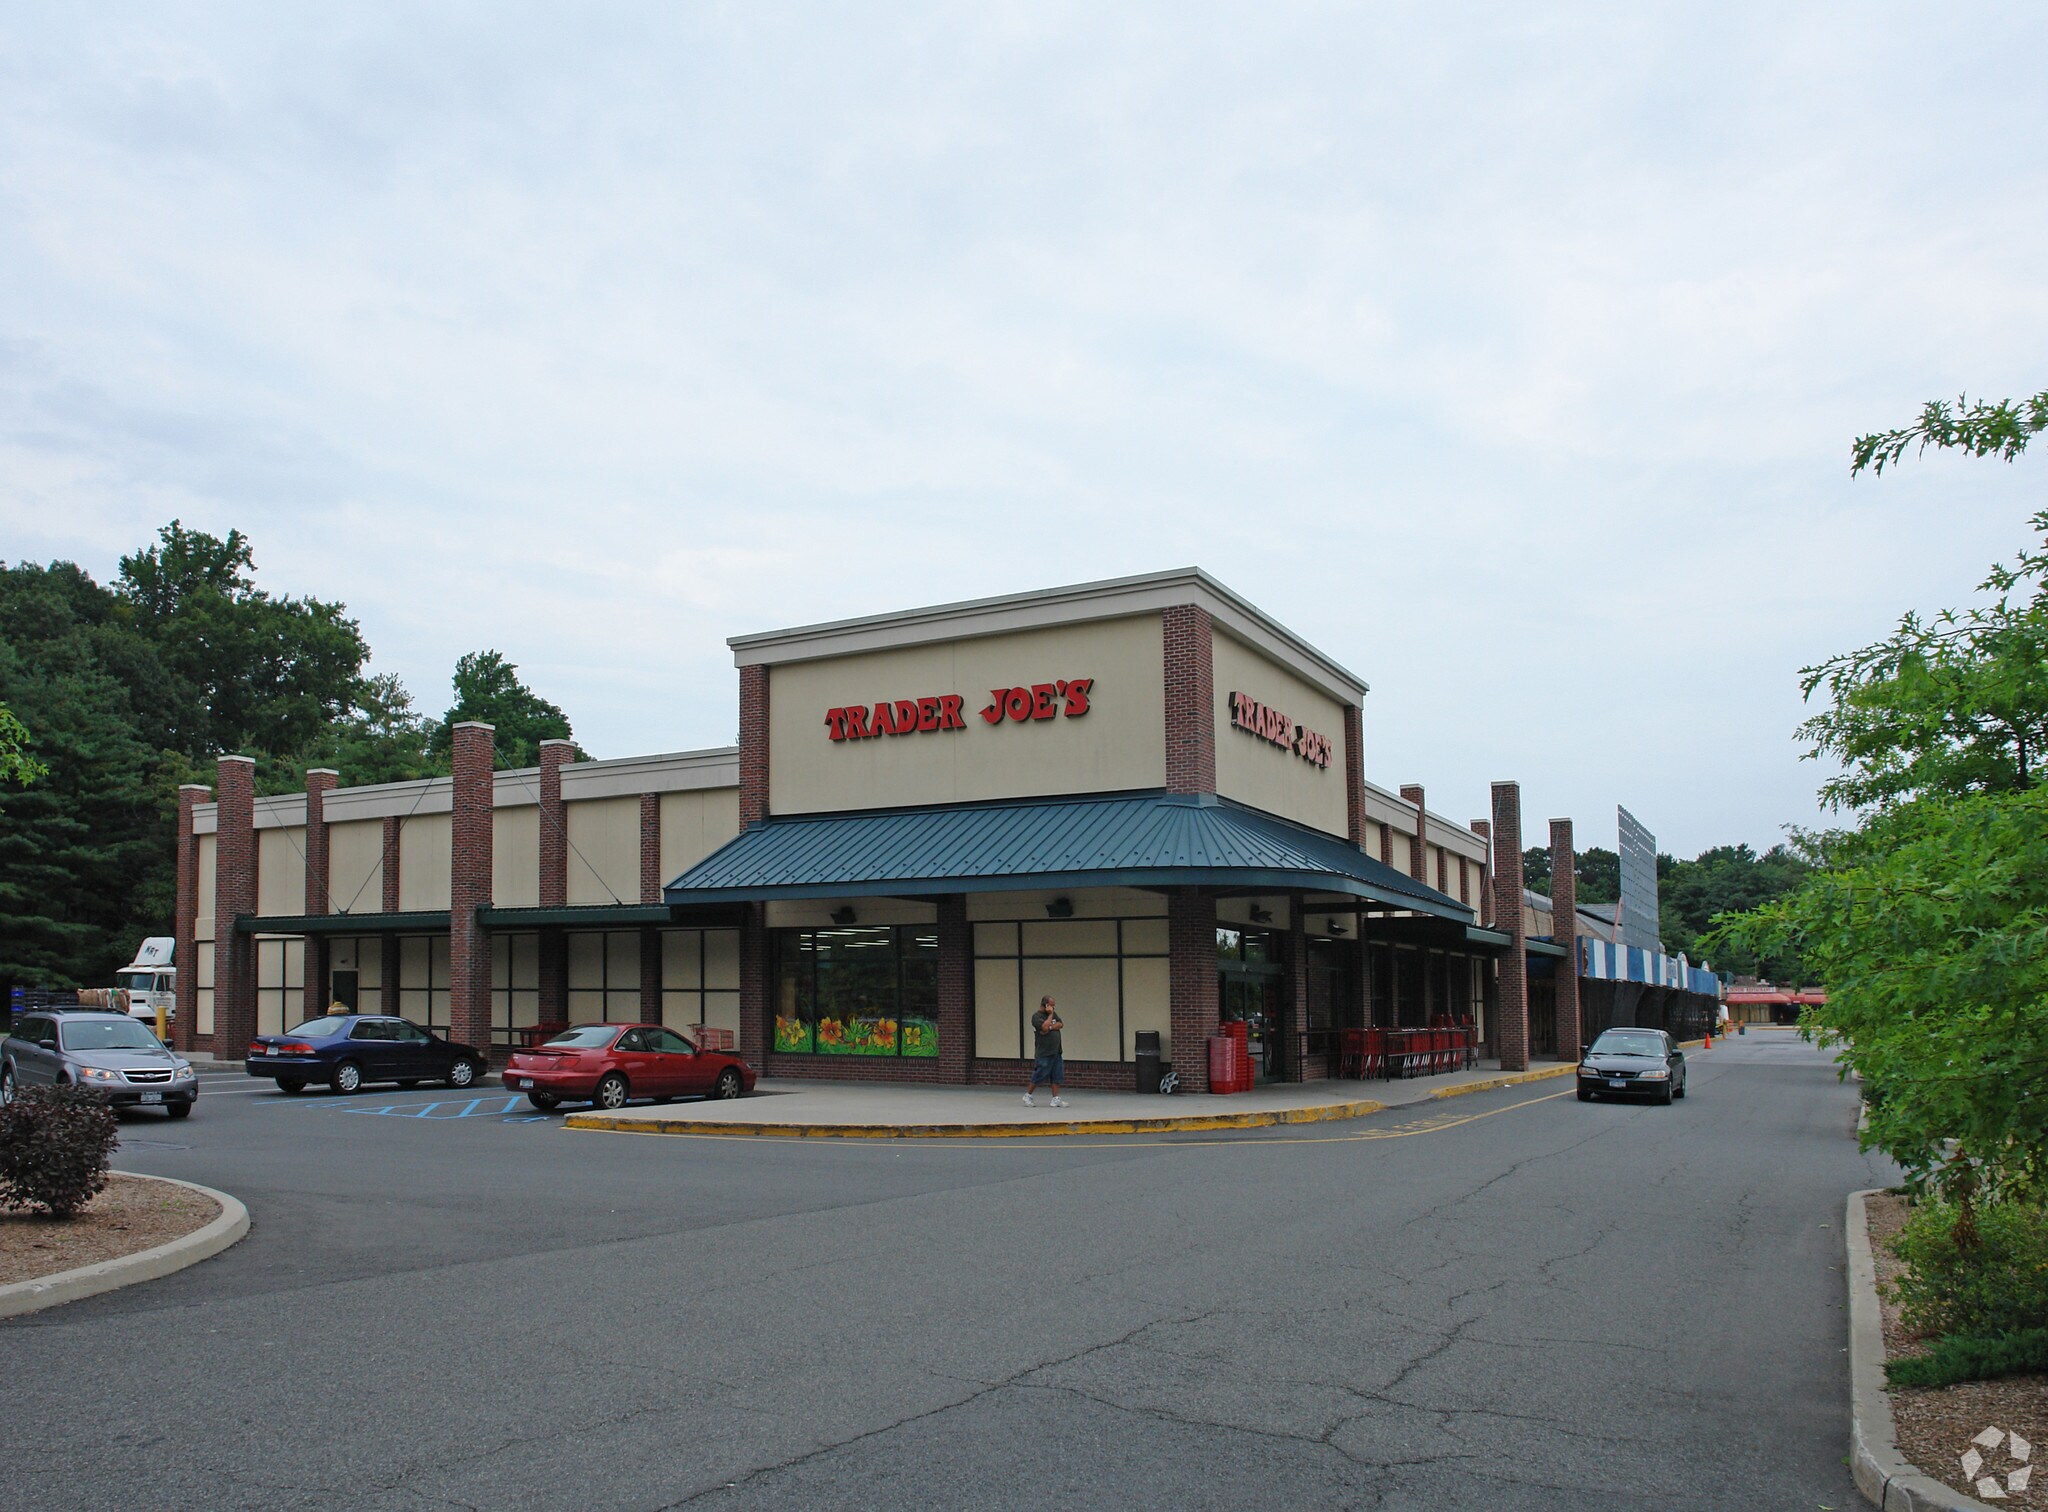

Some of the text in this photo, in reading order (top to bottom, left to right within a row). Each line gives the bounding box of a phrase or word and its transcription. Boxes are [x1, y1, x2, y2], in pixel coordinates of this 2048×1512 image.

[824, 678, 1094, 741] TRADER JOE'S
[1229, 691, 1333, 769] TRADER JOE'S
